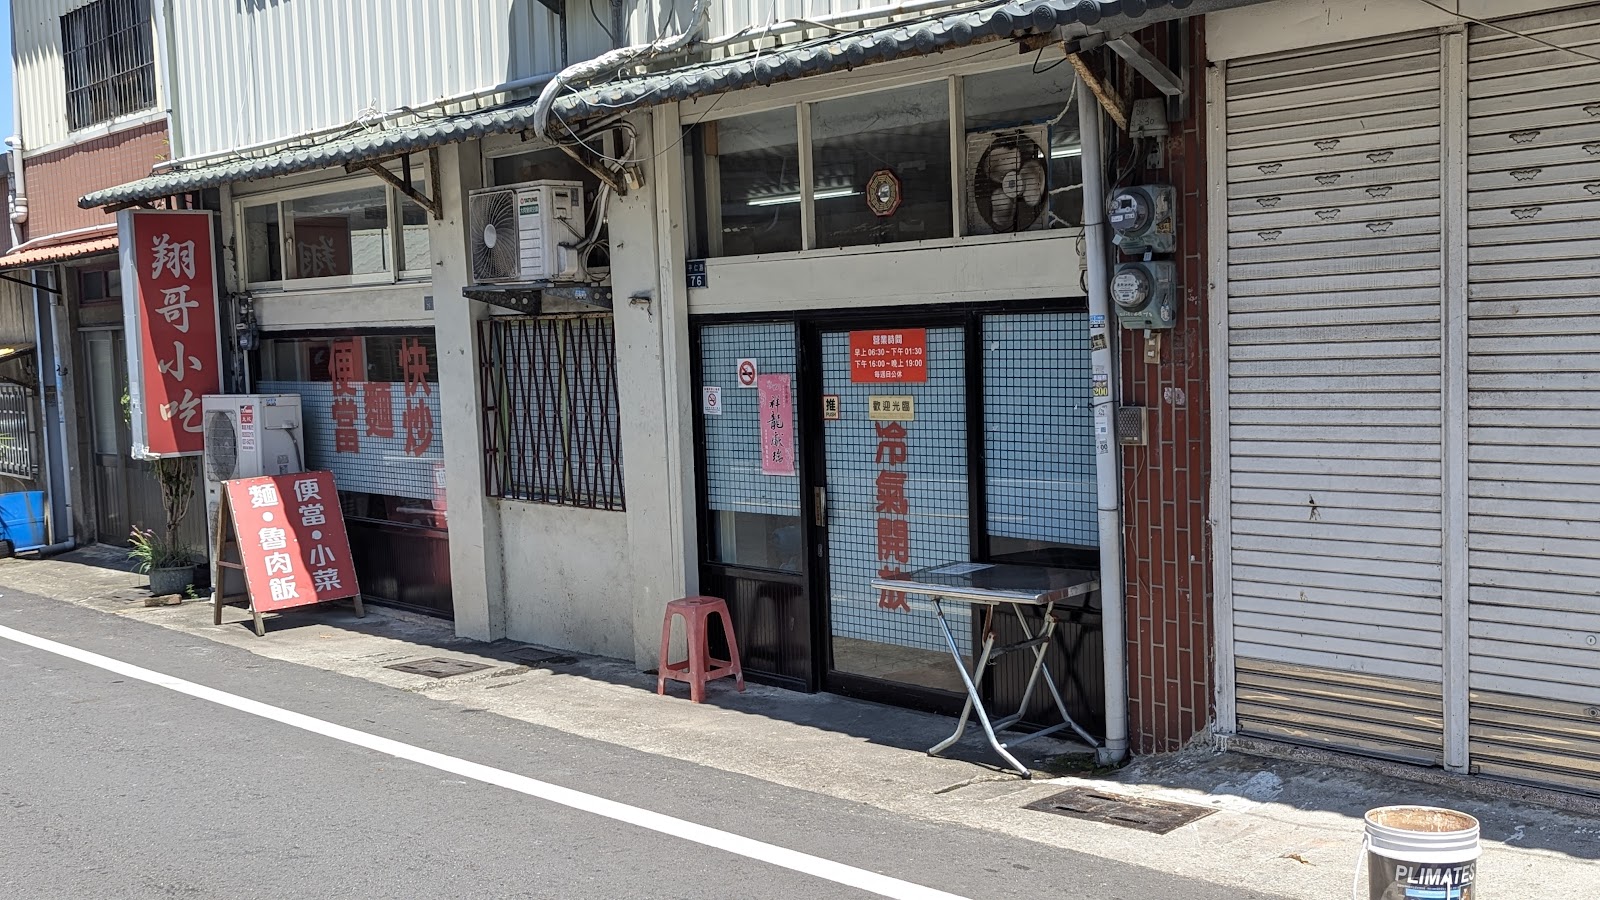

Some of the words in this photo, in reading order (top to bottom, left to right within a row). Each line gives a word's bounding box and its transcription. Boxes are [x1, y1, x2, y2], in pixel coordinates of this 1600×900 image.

[690, 276, 702, 286] 76
[152, 233, 204, 433] 翔哥小吃
[872, 335, 903, 345] 營業時間
[874, 370, 903, 378] 每週日公休
[328, 338, 360, 454] 便當
[399, 337, 434, 457] 快炒
[825, 398, 836, 411] 推
[872, 400, 911, 412] 歡迎光臨
[875, 421, 911, 612] 冷氣開放
